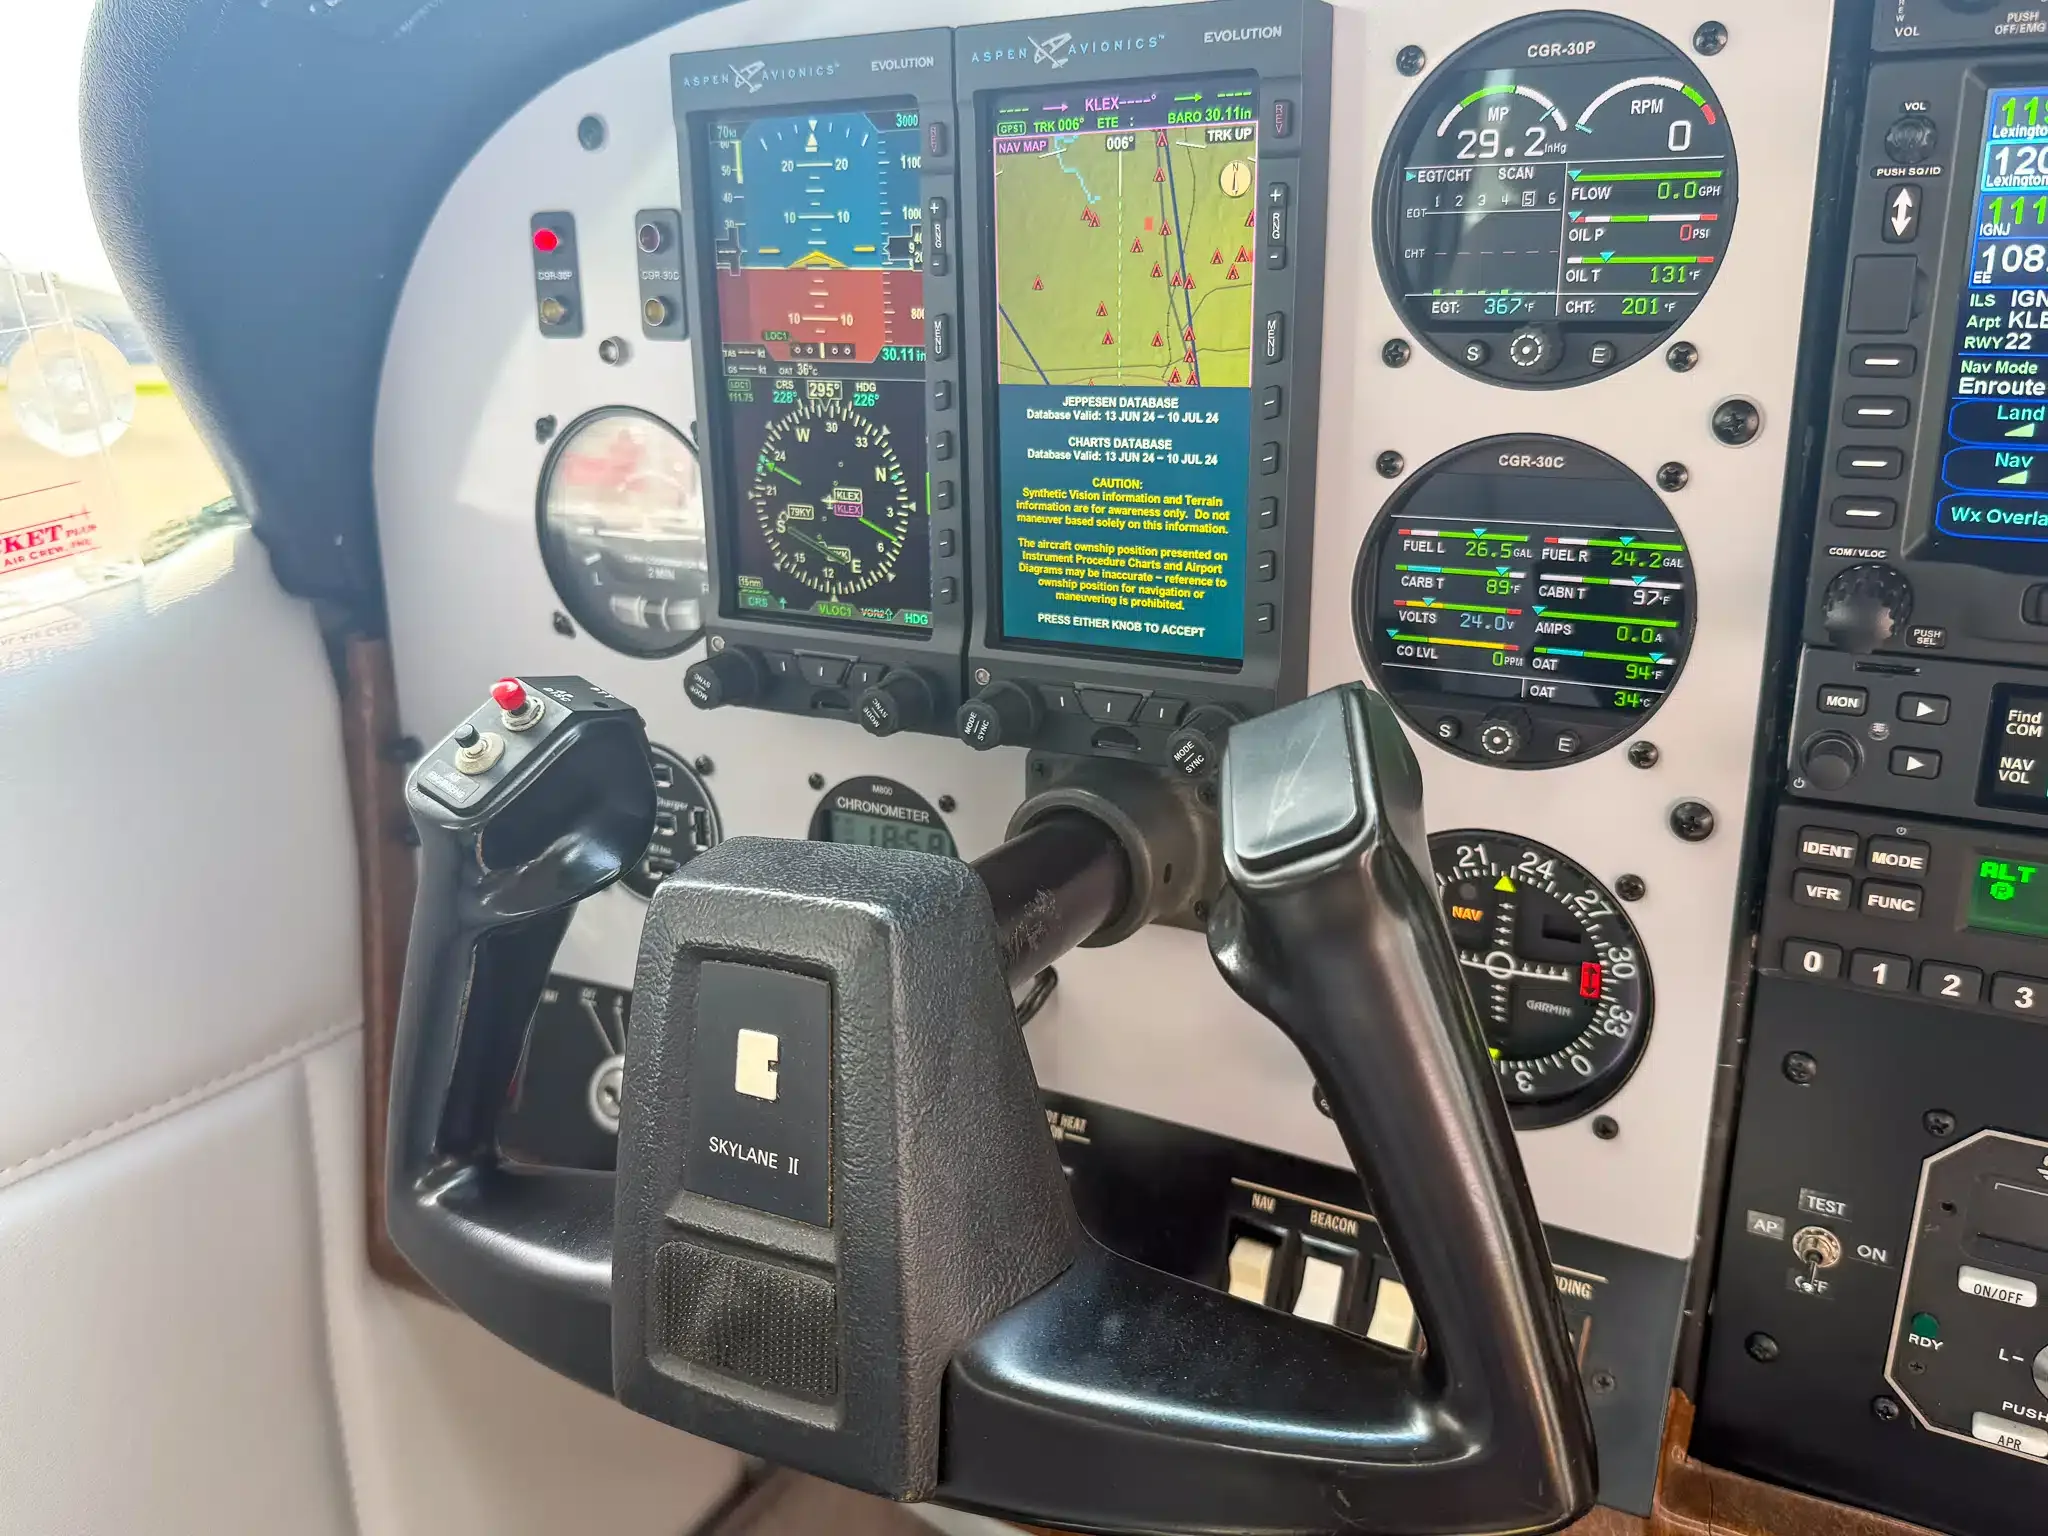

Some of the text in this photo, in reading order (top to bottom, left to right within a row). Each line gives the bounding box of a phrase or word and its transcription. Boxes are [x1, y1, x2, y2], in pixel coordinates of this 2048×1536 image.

[2007, 12, 2039, 23] PUSH
[1204, 26, 1282, 43] EVOLUTION
[1895, 27, 1919, 37] VOL
[1995, 23, 2046, 34] OFF/EMG
[972, 48, 1027, 62] ASPEN
[1527, 41, 1596, 57] CGR-30P
[871, 56, 934, 72] EVOLUTION
[684, 73, 729, 86] ASPEN
[1631, 100, 1663, 115] RPM
[1905, 102, 1926, 110] VOL
[896, 113, 918, 128] 3000
[1168, 110, 1201, 123] BARO
[1488, 107, 1509, 122] MP
[1000, 122, 1055, 133] GPS1 TRK
[1097, 117, 1118, 128] ETE
[1208, 128, 1252, 141] TRK UP
[1668, 120, 1691, 151] 0
[999, 140, 1047, 154] NAV MAP
[781, 160, 794, 172] 20
[836, 159, 848, 170] 20
[1877, 167, 1940, 176] PUSH SQ/ID
[1418, 167, 1534, 183] EGT/CHT SCAN
[1571, 187, 1610, 200] FLOW
[784, 212, 796, 223] 10
[837, 212, 850, 223] 10
[1568, 229, 1591, 241] OIL
[1980, 224, 2010, 236] IGNJ
[1565, 269, 1590, 282] OIL
[1432, 301, 1460, 314] EGT:
[1565, 301, 1596, 314] CHT:
[1970, 294, 1995, 307] ILS
[788, 314, 800, 324] 10
[841, 315, 853, 326] 10
[1966, 315, 2001, 331] Arpt
[1964, 332, 2032, 350] RWY 22
[1961, 360, 2038, 374] Nav Mode
[776, 381, 793, 389] CRS
[856, 383, 876, 391] HDG
[1958, 377, 2045, 395] Enroute
[1062, 396, 1178, 408] JEPPESEN DATABASE
[1027, 410, 1102, 421] Database Valid:
[1997, 405, 2044, 421] Land
[796, 429, 810, 442] W
[1068, 437, 1172, 450] CHARTS DATABASE
[1028, 449, 1102, 461] Database Valid:
[1498, 455, 1564, 468] CGR-30C
[1995, 453, 2033, 468] Nav
[875, 468, 886, 481] N
[1092, 478, 1142, 490] CAUTION:
[1022, 488, 1222, 506] Synthetic Vision Terrain
[1016, 500, 1160, 516] information awareness
[1951, 507, 1980, 522] Wx
[1017, 515, 1228, 534] maneuver based solely information.
[1038, 540, 1211, 561] aircraft ownship position presented
[1403, 540, 1434, 551] FUEL
[1829, 547, 1887, 558] COM/VLOC
[1022, 551, 1222, 574] Instrument Procedure Charts Airport
[1542, 550, 1575, 561] FUEL
[1019, 563, 1212, 586] Diagrams inaccurate reference
[1038, 578, 1191, 598] ownship position navigation
[1401, 577, 1433, 587] CARB
[1538, 586, 1572, 598] CABN
[1056, 590, 1184, 610] maneuvering prohibited.
[905, 613, 928, 624] HDG
[1399, 611, 1436, 624] VOLTS
[1038, 613, 1205, 637] PRESS EITHER KNOB ACCEPT
[1535, 622, 1572, 635] AMPS
[1914, 629, 1941, 638] PUSH
[1917, 637, 1935, 645] SEL
[1396, 646, 1438, 659] CO LVL
[1533, 659, 1557, 670] OAT
[1530, 686, 1555, 698] OAT
[1827, 696, 1858, 708] MON
[2008, 710, 2042, 724] Find
[2006, 723, 2042, 737] COM
[1174, 741, 1195, 762] MODE
[2001, 757, 2034, 771] NAV
[1998, 770, 2030, 784] VOL
[837, 796, 929, 823] CHRONOMETER
[1456, 843, 1489, 867] 21
[1803, 841, 1853, 858] IDENT
[1518, 851, 1554, 879] 24
[1872, 852, 1923, 869] MODE
[1980, 861, 2036, 883] ALT
[1806, 885, 1841, 900] VFR
[1574, 890, 1613, 918] 27
[1868, 895, 1915, 911] FUNC
[1452, 906, 1484, 921] NAV
[1608, 947, 1635, 979] 30
[1803, 951, 1821, 972] 0
[1873, 964, 1887, 984] 1
[1941, 974, 1961, 996] 2
[2015, 986, 2033, 1008] 3
[1526, 1000, 1571, 1016] GARMIN
[1603, 1005, 1633, 1038] 33
[709, 1137, 778, 1169] SKYLANE
[1252, 1193, 1276, 1213] NAV
[1807, 1196, 1846, 1215] TEST
[1310, 1210, 1359, 1238] BEACON
[1754, 1220, 1778, 1233] AP
[1857, 1245, 1886, 1261] ON
[1974, 1284, 2023, 1304] ON/OFF
[1909, 1334, 1943, 1350] RDY
[1998, 1436, 2021, 1450] APR
